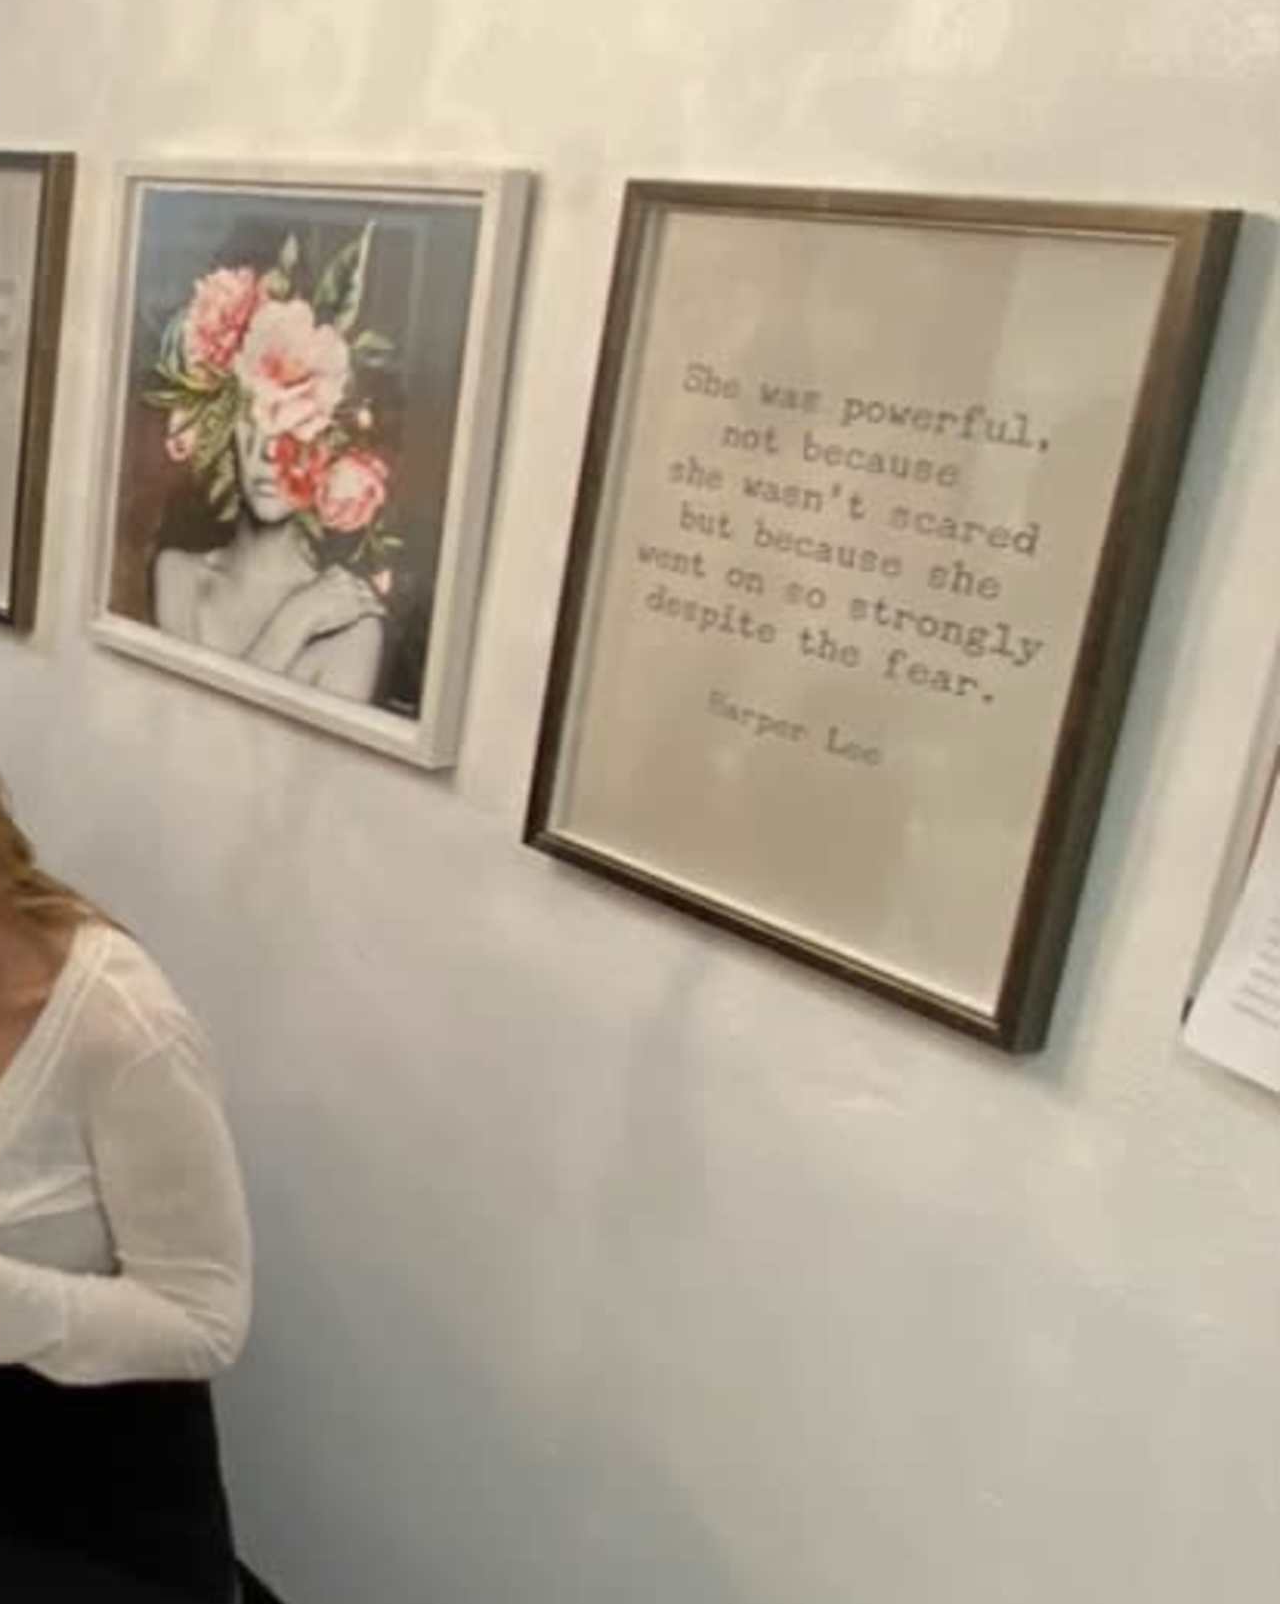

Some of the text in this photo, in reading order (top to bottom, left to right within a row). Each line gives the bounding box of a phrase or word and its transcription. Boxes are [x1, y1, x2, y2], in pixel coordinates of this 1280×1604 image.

[683, 363, 740, 399] She
[759, 383, 820, 413] was
[668, 454, 1041, 555] she wasn't scared
[722, 424, 960, 487] not because
[680, 500, 1001, 600] but because she
[638, 544, 1044, 667] went on so strongly
[645, 584, 994, 705] despite the fear.
